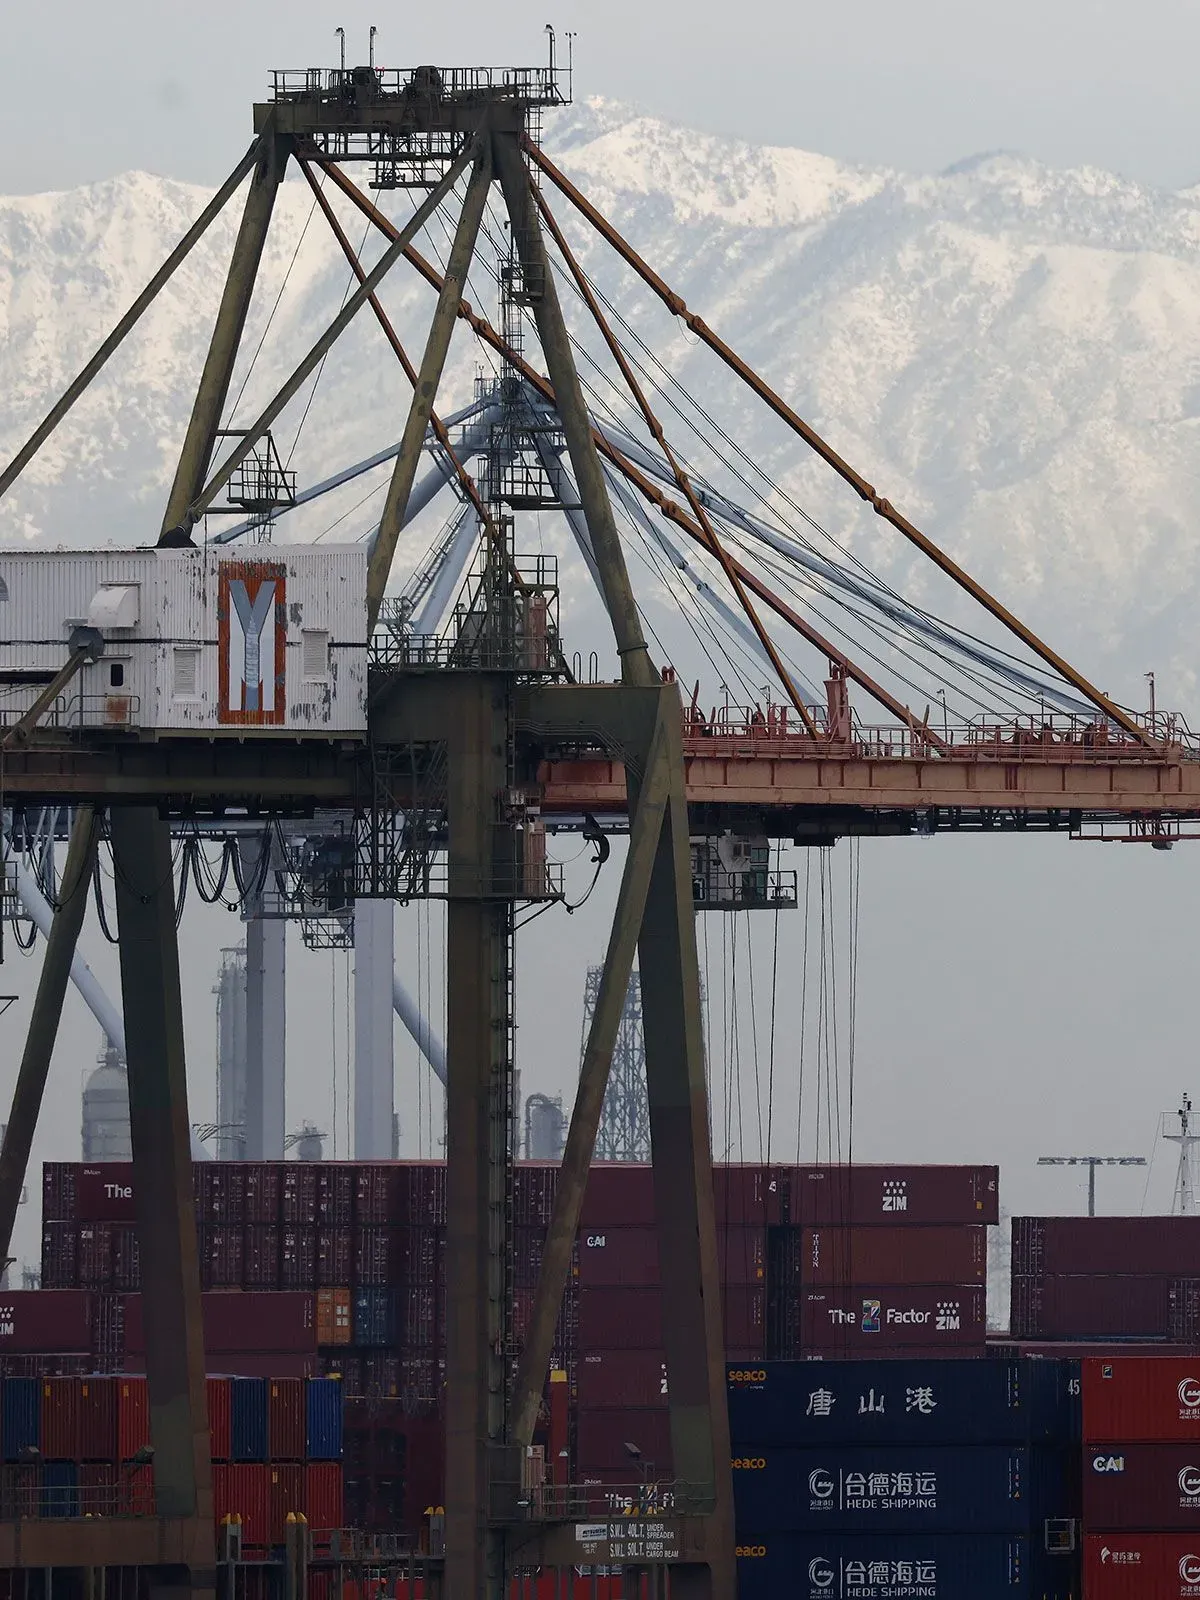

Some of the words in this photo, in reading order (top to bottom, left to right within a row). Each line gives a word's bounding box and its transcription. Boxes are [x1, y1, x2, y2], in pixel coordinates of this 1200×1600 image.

[104, 1184, 132, 1198] The
[883, 1196, 907, 1211] ZIM
[586, 1236, 606, 1247] CAI
[828, 1310, 856, 1324] The
[887, 1309, 931, 1324] Factor
[0, 1322, 14, 1335] IM
[936, 1317, 960, 1330] ZIM
[729, 1370, 767, 1382] seaco
[1068, 1379, 1081, 1396] 45
[806, 1387, 938, 1416] 唐山港
[1092, 1456, 1125, 1472] CAI
[846, 1472, 937, 1496] 台德海运
[847, 1499, 878, 1509] HEDE
[882, 1499, 937, 1509] SHIPPING
[646, 1531, 675, 1539] SPREADER
[646, 1542, 664, 1550] UNDER
[735, 1546, 767, 1557] eaco
[646, 1550, 663, 1558] CARGO
[664, 1550, 679, 1558] BEAM
[845, 1560, 937, 1584] 台德海运
[847, 1587, 877, 1597] HEDE
[881, 1587, 936, 1597] SHIPPING
